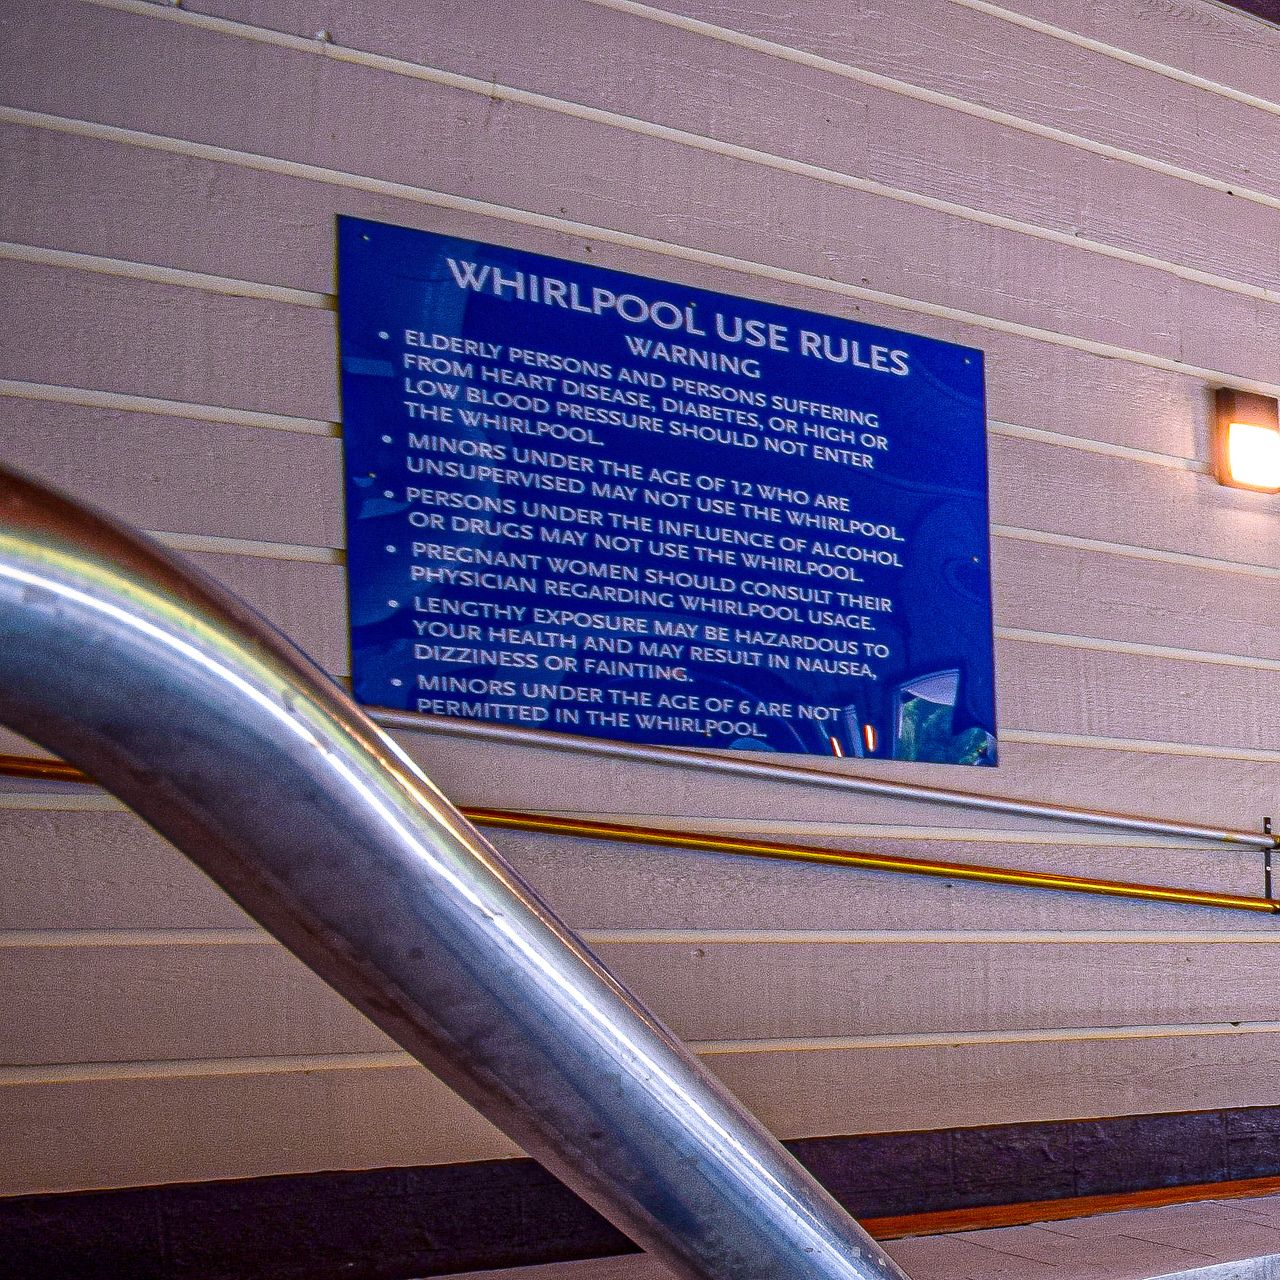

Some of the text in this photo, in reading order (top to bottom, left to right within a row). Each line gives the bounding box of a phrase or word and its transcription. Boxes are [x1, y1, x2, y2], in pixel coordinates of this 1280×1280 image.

[446, 258, 910, 376] WHIRLPOOL USE RULES
[405, 330, 879, 428] ELDERLY PERSONS AND PERSONS SUFFERING
[624, 336, 761, 378] WARNING
[403, 353, 889, 450] FROM HEART DISEASE, DIABETES, OR HIGH OR
[403, 401, 454, 423] THE
[405, 378, 874, 469] LOW BLOOD PRESSURE SHOULD NOT ENTER
[407, 458, 906, 541] UNSUPERVISED MAY NOT USE THE WHIRLPOOL.
[408, 433, 851, 512] MINORS UNDER THE AGE OF 12 WHO ARE
[406, 487, 904, 567] PERSONS UNDER THE INFLUENCE OF ALCOHOL
[408, 512, 864, 582] OR DRUGS MAY NOT USE THE WHIRLPOOL.
[410, 565, 876, 630] PHYSICIAN REGARDING WHIRLPOOL USAGE.
[412, 542, 893, 612] PREGNANT WOMEN SHOULD CONSULT THEIR
[413, 620, 878, 680] YOUR HEALTH AND MAY RESULT IN NAUSEA,
[415, 597, 890, 658] LENGTHY EXPOSURE MAY BE HAZARDOUS TO
[414, 644, 694, 682] DIZZINESS OR FAINTING.
[417, 675, 841, 721] MINORS UNDER THE AGE OF 6 ARE NOT
[418, 699, 549, 721] PERMITTED
[556, 709, 579, 723] IN
[585, 711, 630, 727] THE
